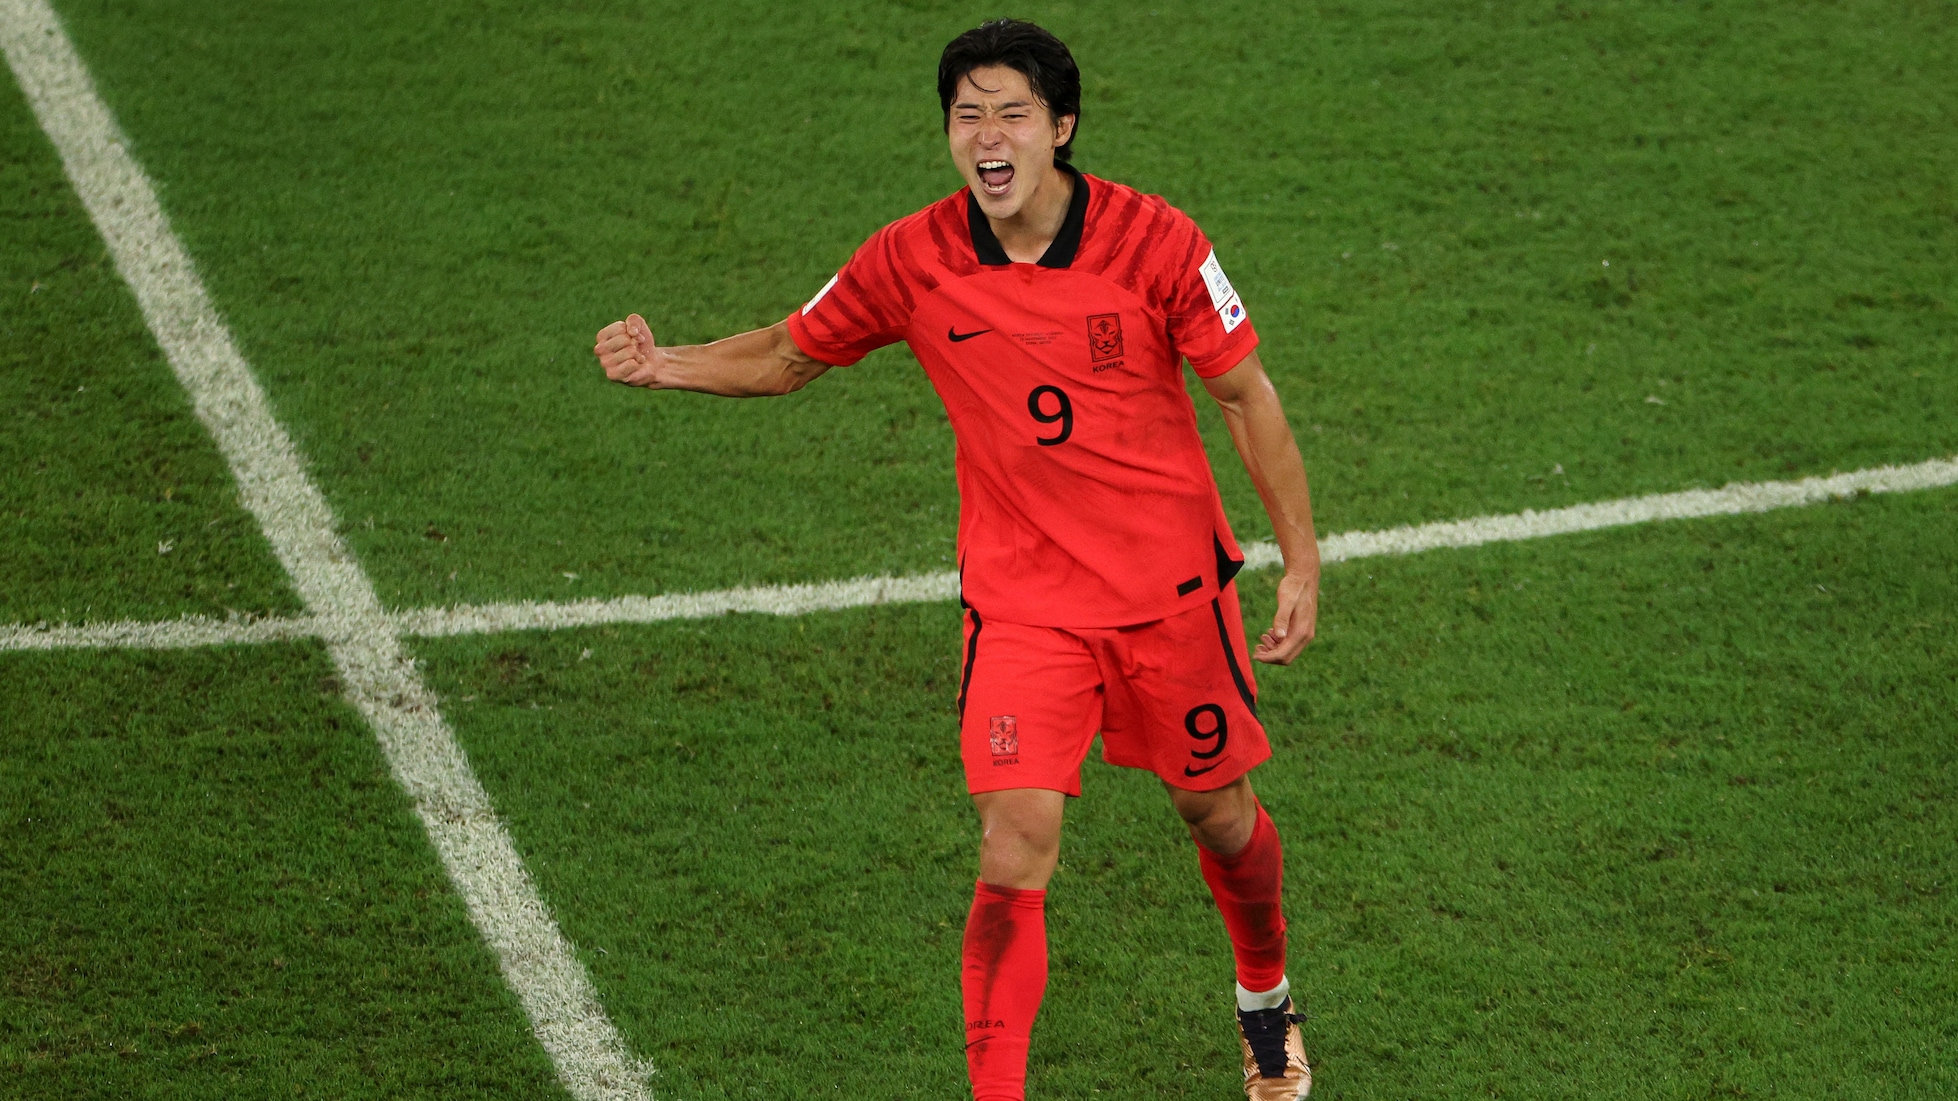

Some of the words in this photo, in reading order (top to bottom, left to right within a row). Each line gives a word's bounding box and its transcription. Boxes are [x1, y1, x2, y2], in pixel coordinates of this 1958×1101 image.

[1093, 360, 1124, 373] KOREA
[1027, 384, 1073, 447] 9
[1184, 703, 1228, 759] 9
[993, 757, 1019, 767] KOREA
[965, 1019, 1005, 1032] OREA
